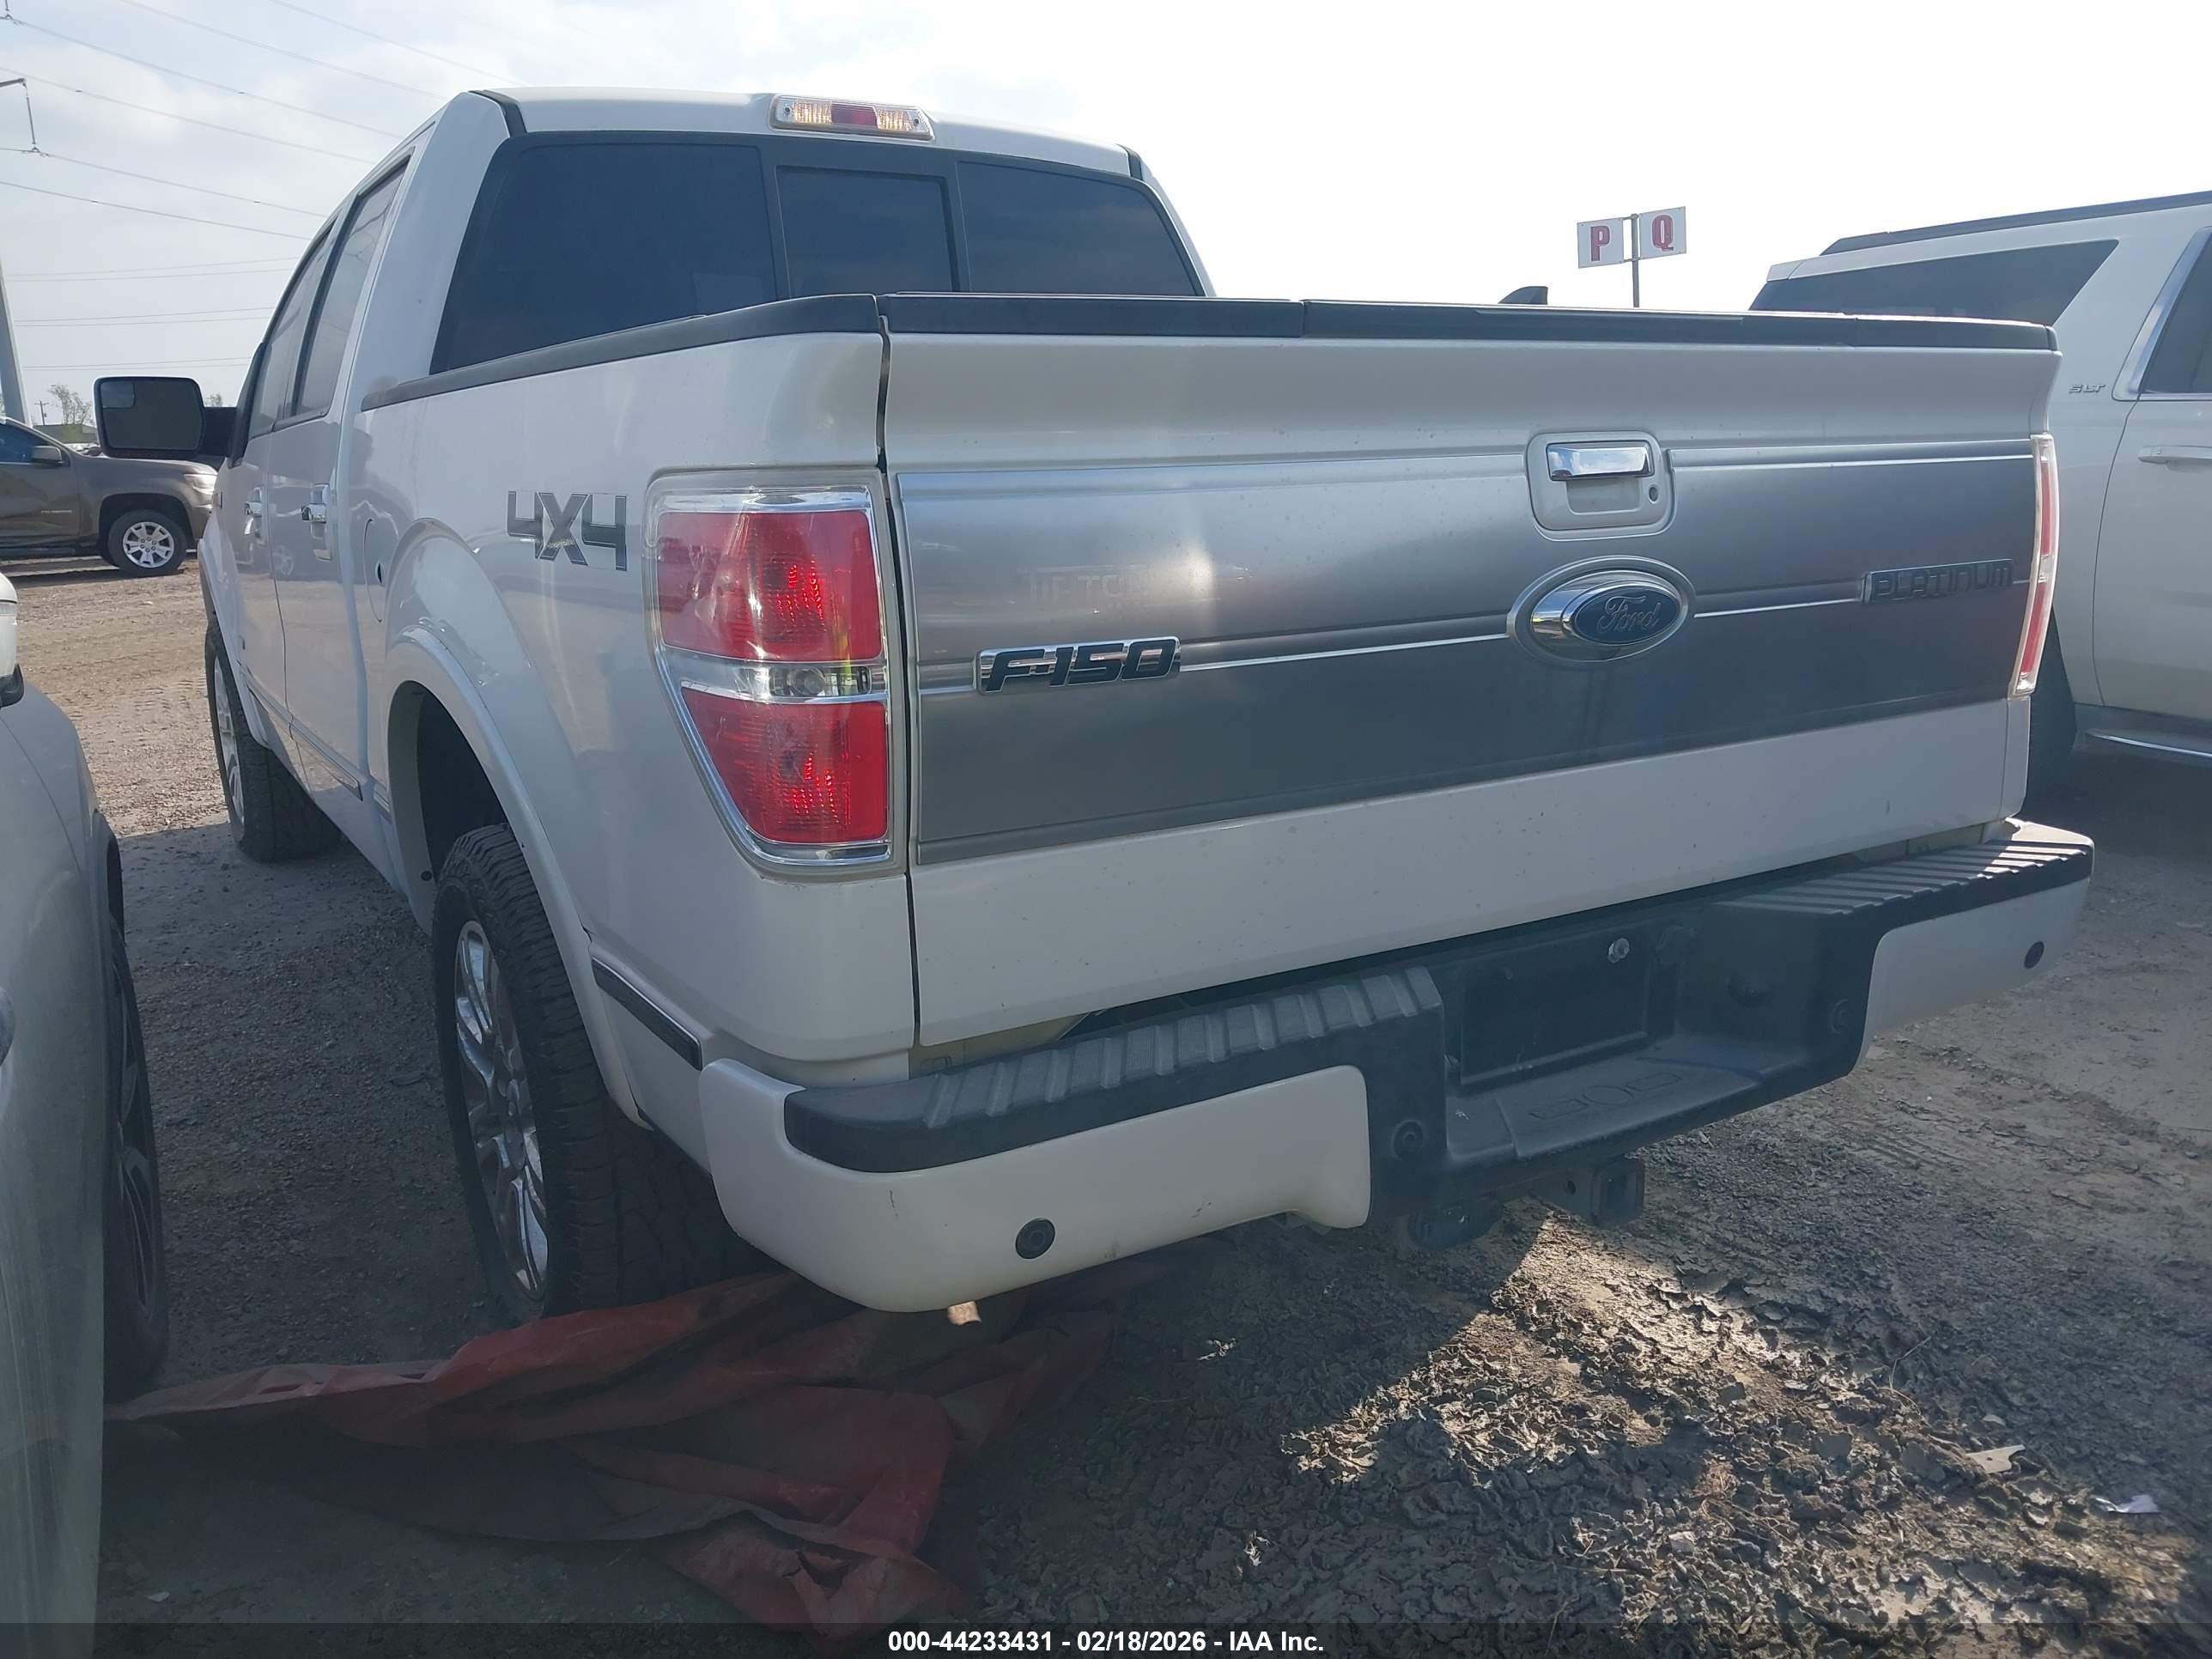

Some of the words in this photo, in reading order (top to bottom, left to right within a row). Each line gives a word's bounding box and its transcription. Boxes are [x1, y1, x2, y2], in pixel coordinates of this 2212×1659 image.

[1590, 226, 1610, 261] P
[1651, 215, 1674, 251] Q
[2069, 384, 2106, 393] SLT
[1870, 561, 2014, 603] PLATINUM
[1597, 595, 1661, 633] Ford
[985, 638, 1178, 692] F-150
